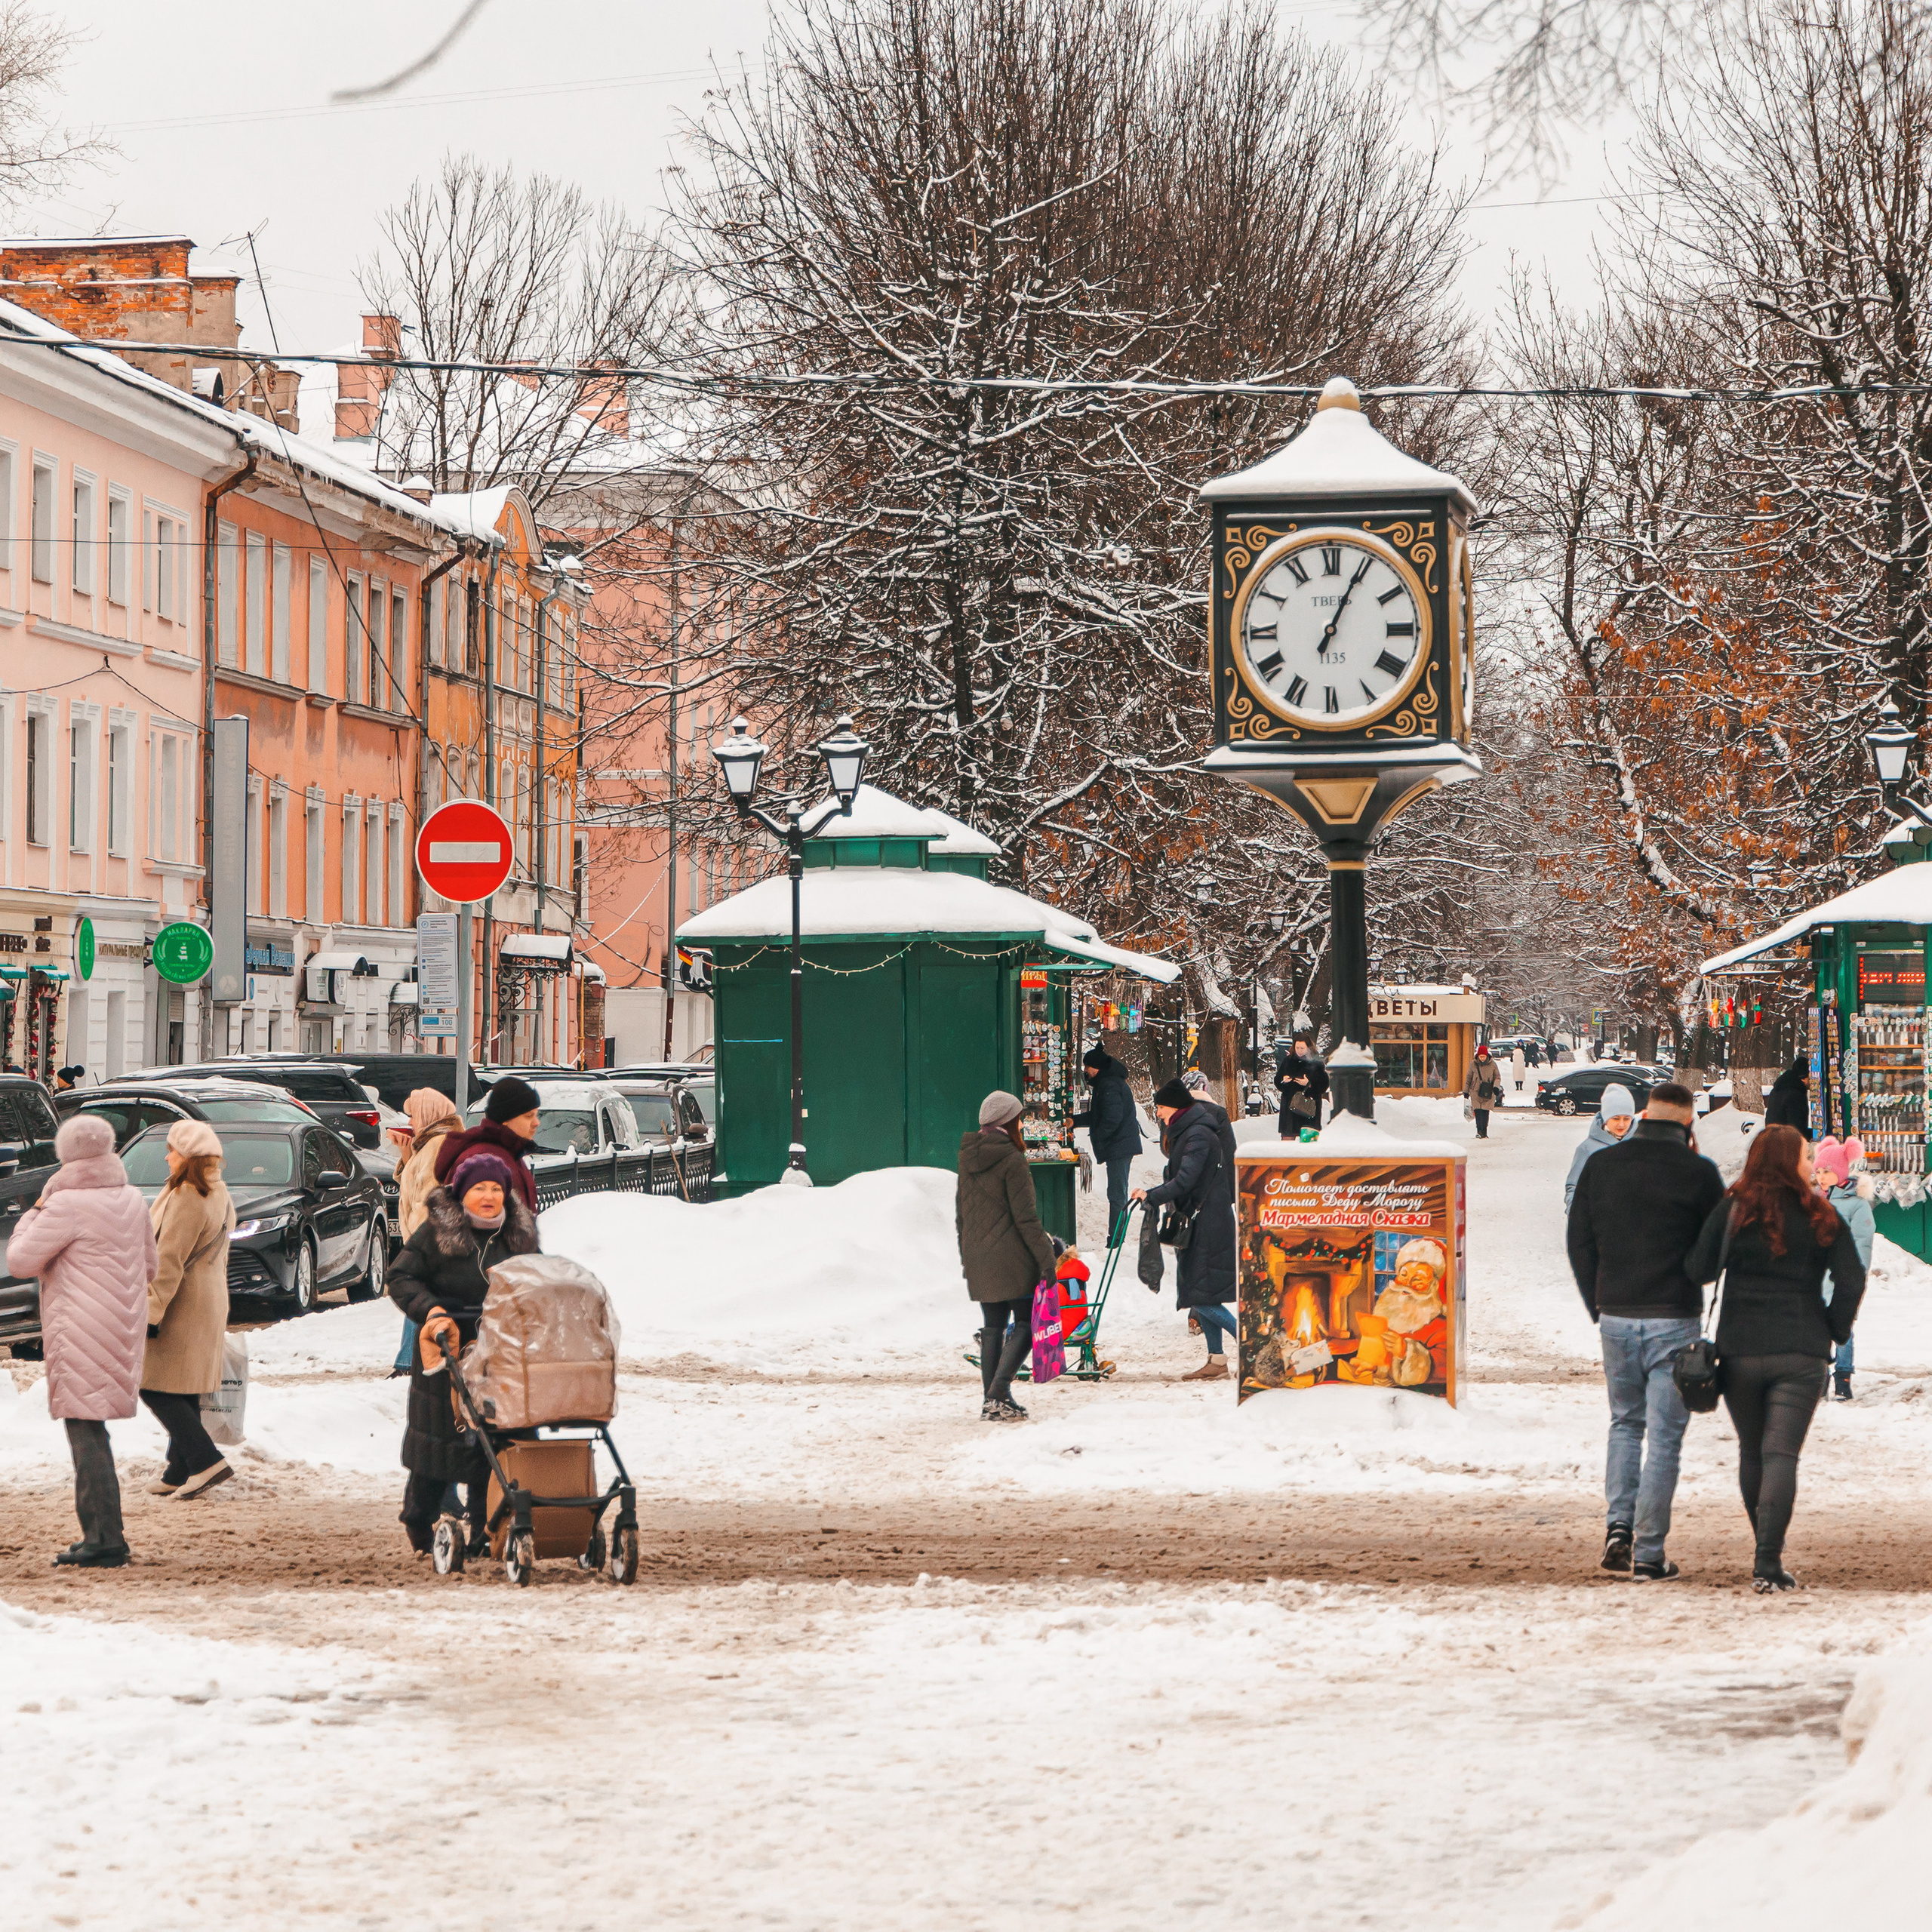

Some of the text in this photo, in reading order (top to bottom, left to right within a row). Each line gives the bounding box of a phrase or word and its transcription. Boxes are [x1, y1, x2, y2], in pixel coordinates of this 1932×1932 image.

[1283, 556, 1312, 588] XI
[1321, 548, 1343, 576] XII
[1257, 583, 1288, 611] X
[1377, 583, 1405, 608] II
[1386, 619, 1415, 638] III
[1320, 652, 1346, 664] 1135
[246, 942, 270, 971] еверная
[1264, 1178, 1430, 1198] Помогает доставлять
[1269, 1192, 1425, 1211] письма Деду Морозу
[389, 1223, 401, 1232] 63
[1261, 1210, 1430, 1229] Мармеладная Сказка
